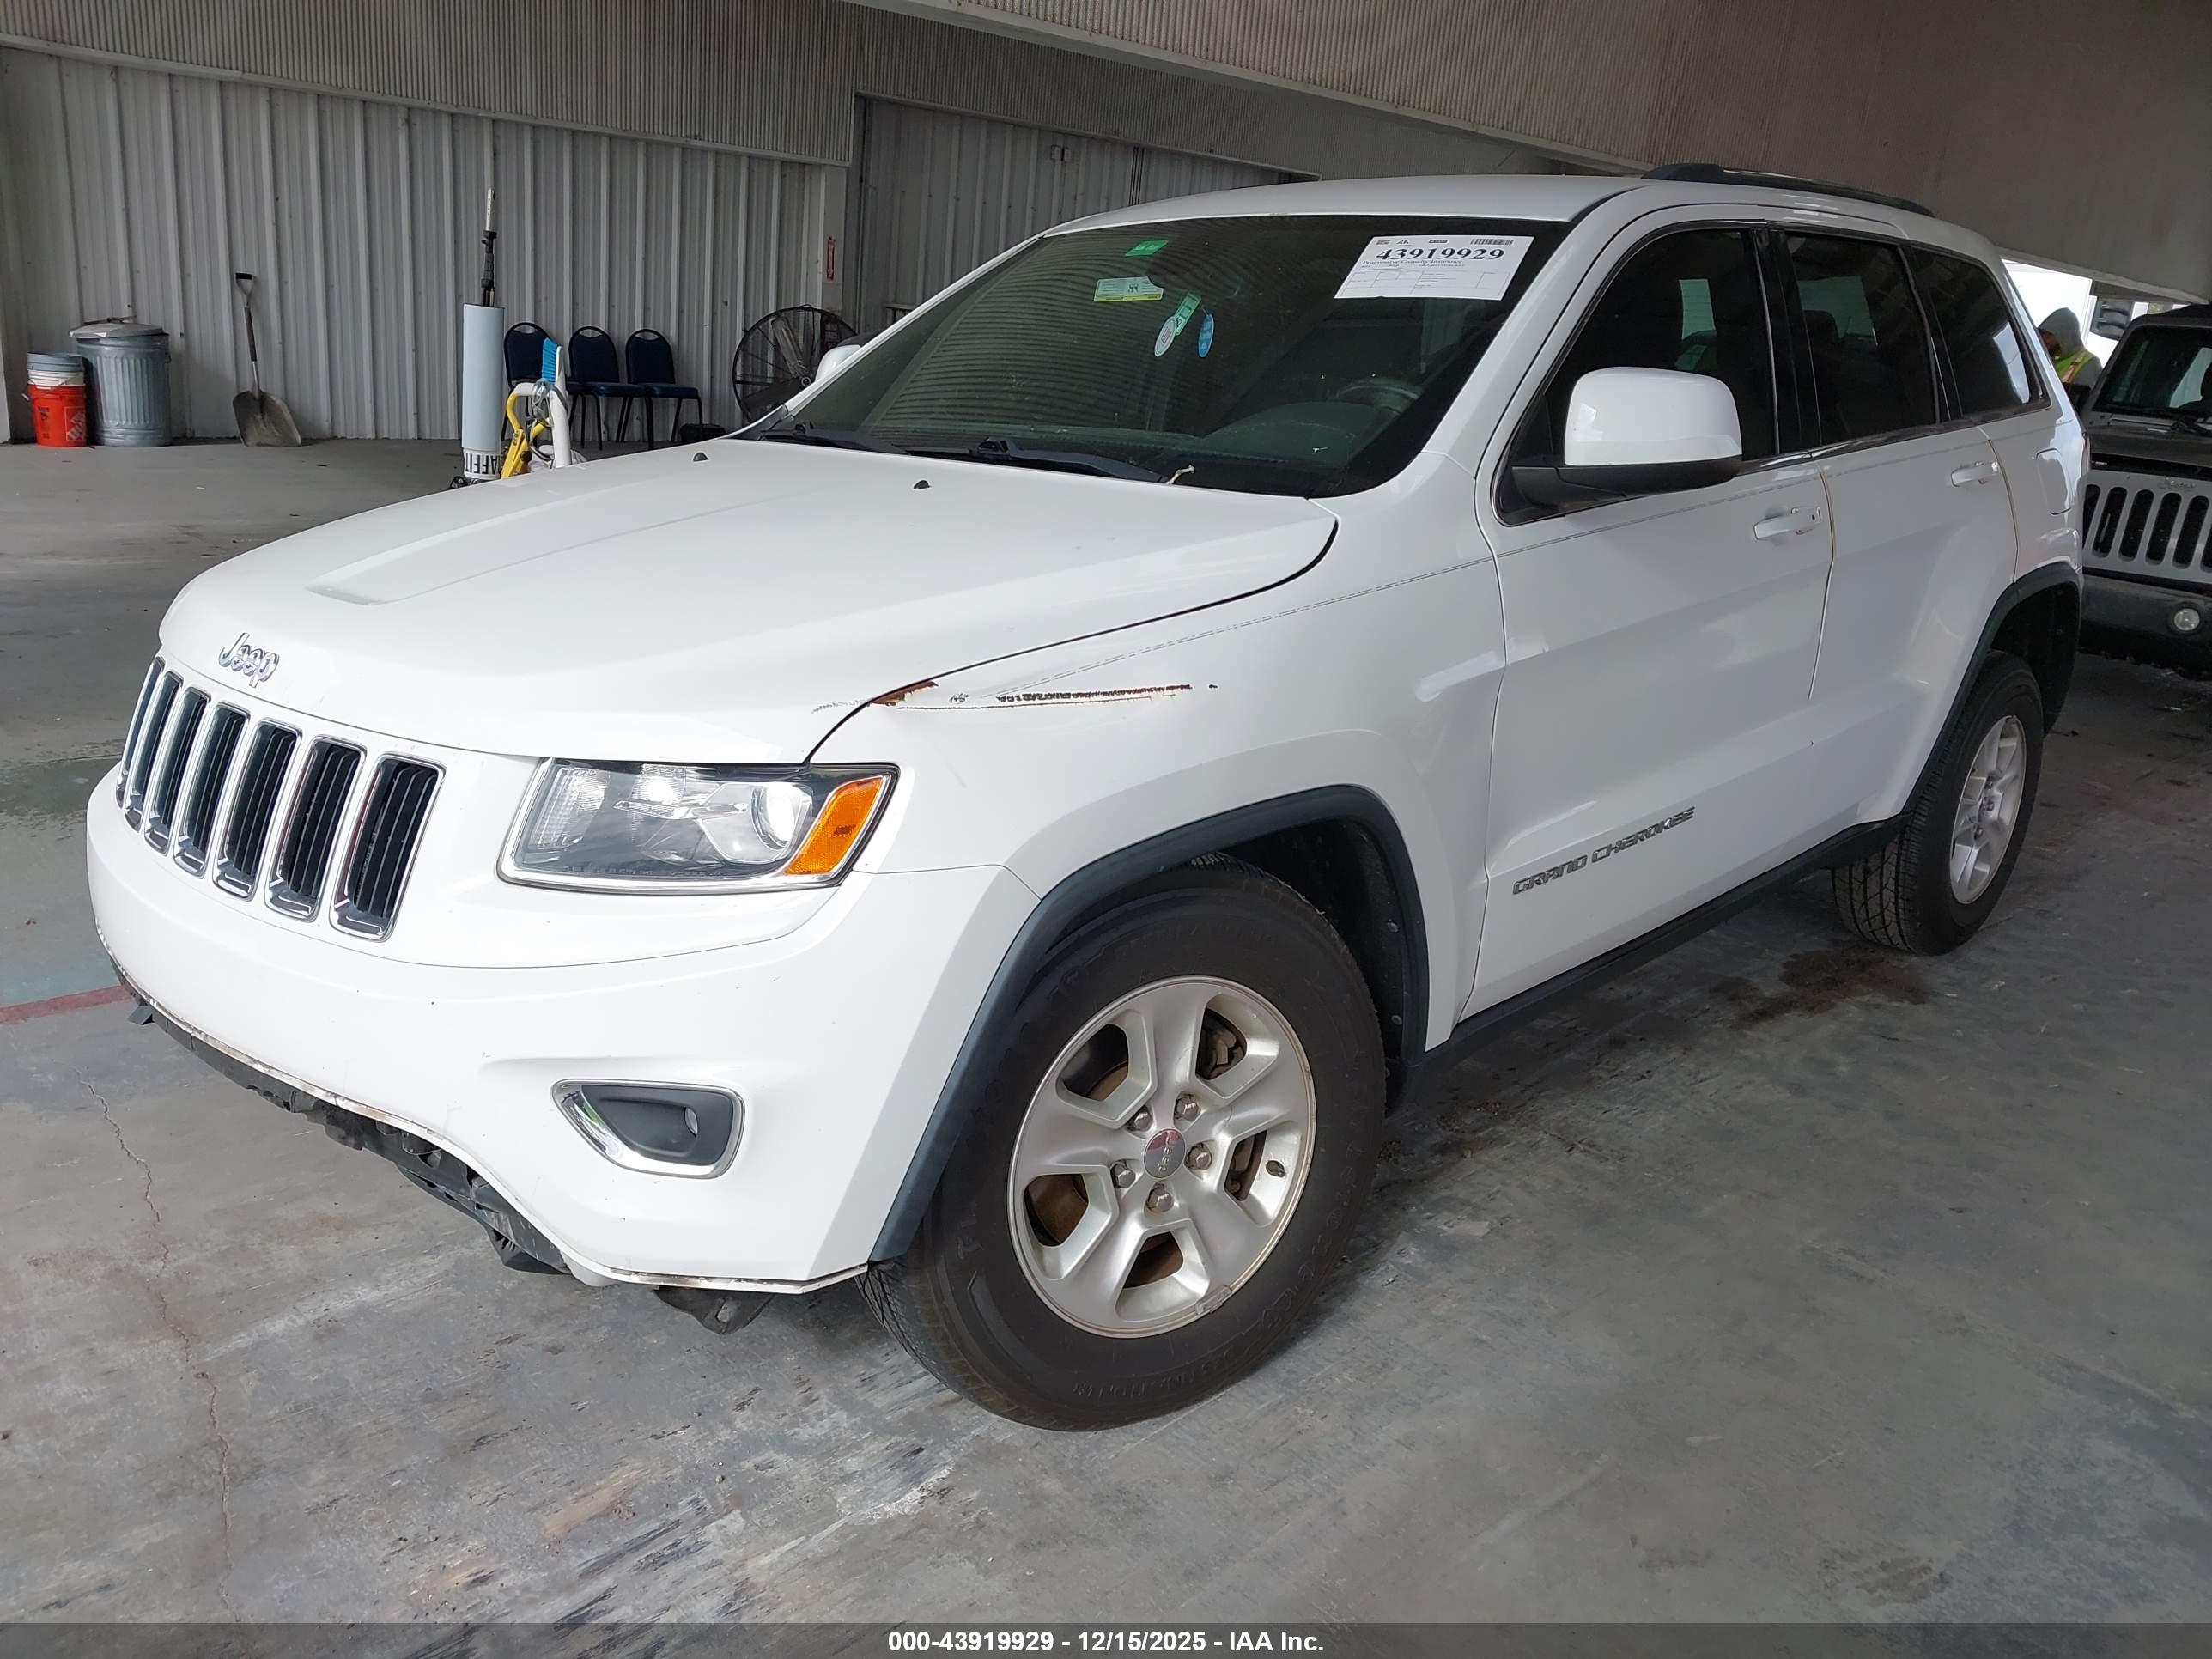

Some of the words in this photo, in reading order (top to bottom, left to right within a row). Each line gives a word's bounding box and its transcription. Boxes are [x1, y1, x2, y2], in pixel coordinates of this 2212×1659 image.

[1376, 247, 1505, 260] 43919929
[218, 632, 280, 689] Jeep
[1513, 854, 1588, 895] GRAND
[1591, 805, 1696, 863] CHEROKEE
